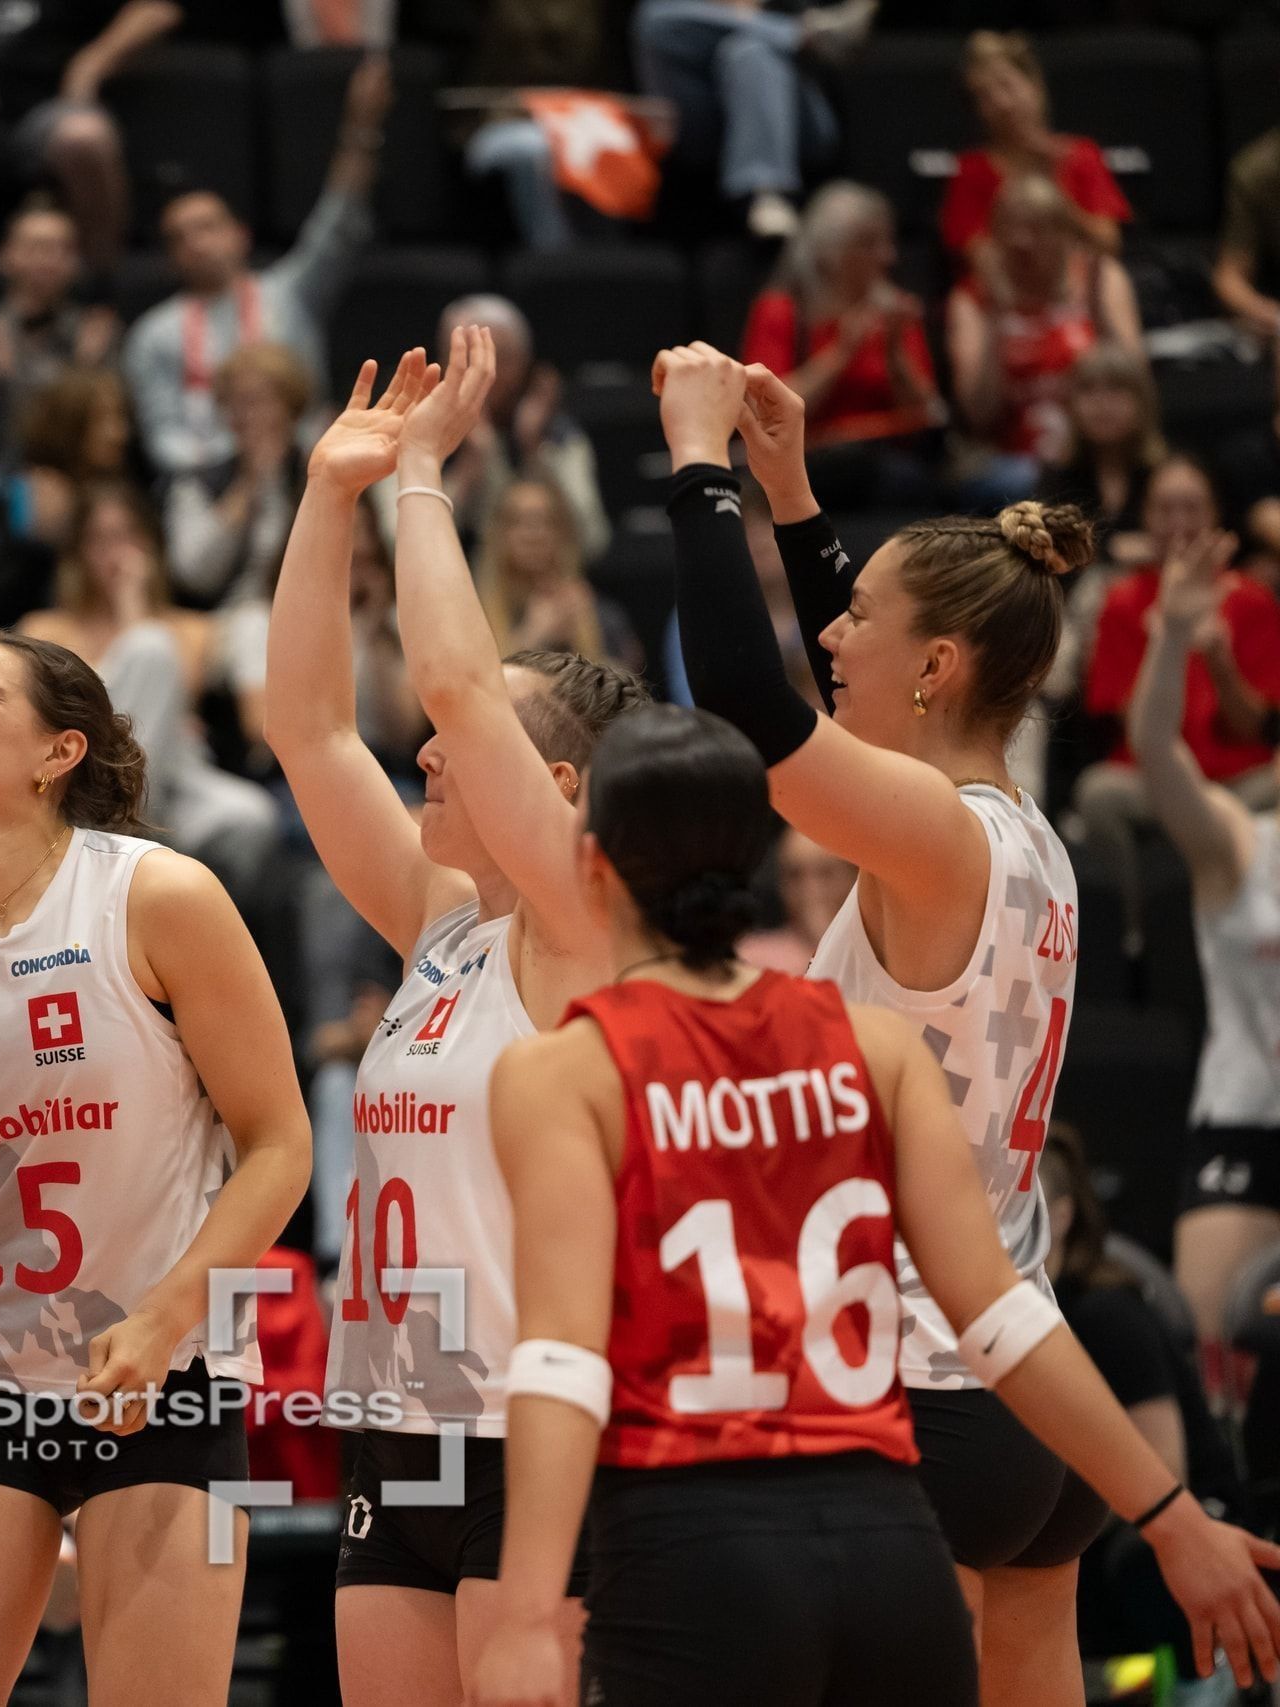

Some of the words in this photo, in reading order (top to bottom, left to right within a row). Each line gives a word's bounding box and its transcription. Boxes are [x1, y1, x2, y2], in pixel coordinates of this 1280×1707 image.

[35, 1047, 86, 1067] SUISSE
[354, 1092, 456, 1135] Mobiliar
[645, 1062, 870, 1152] MOTTIS
[1008, 997, 1067, 1193] 4
[342, 1177, 418, 1325] 10
[660, 1176, 901, 1414] 16
